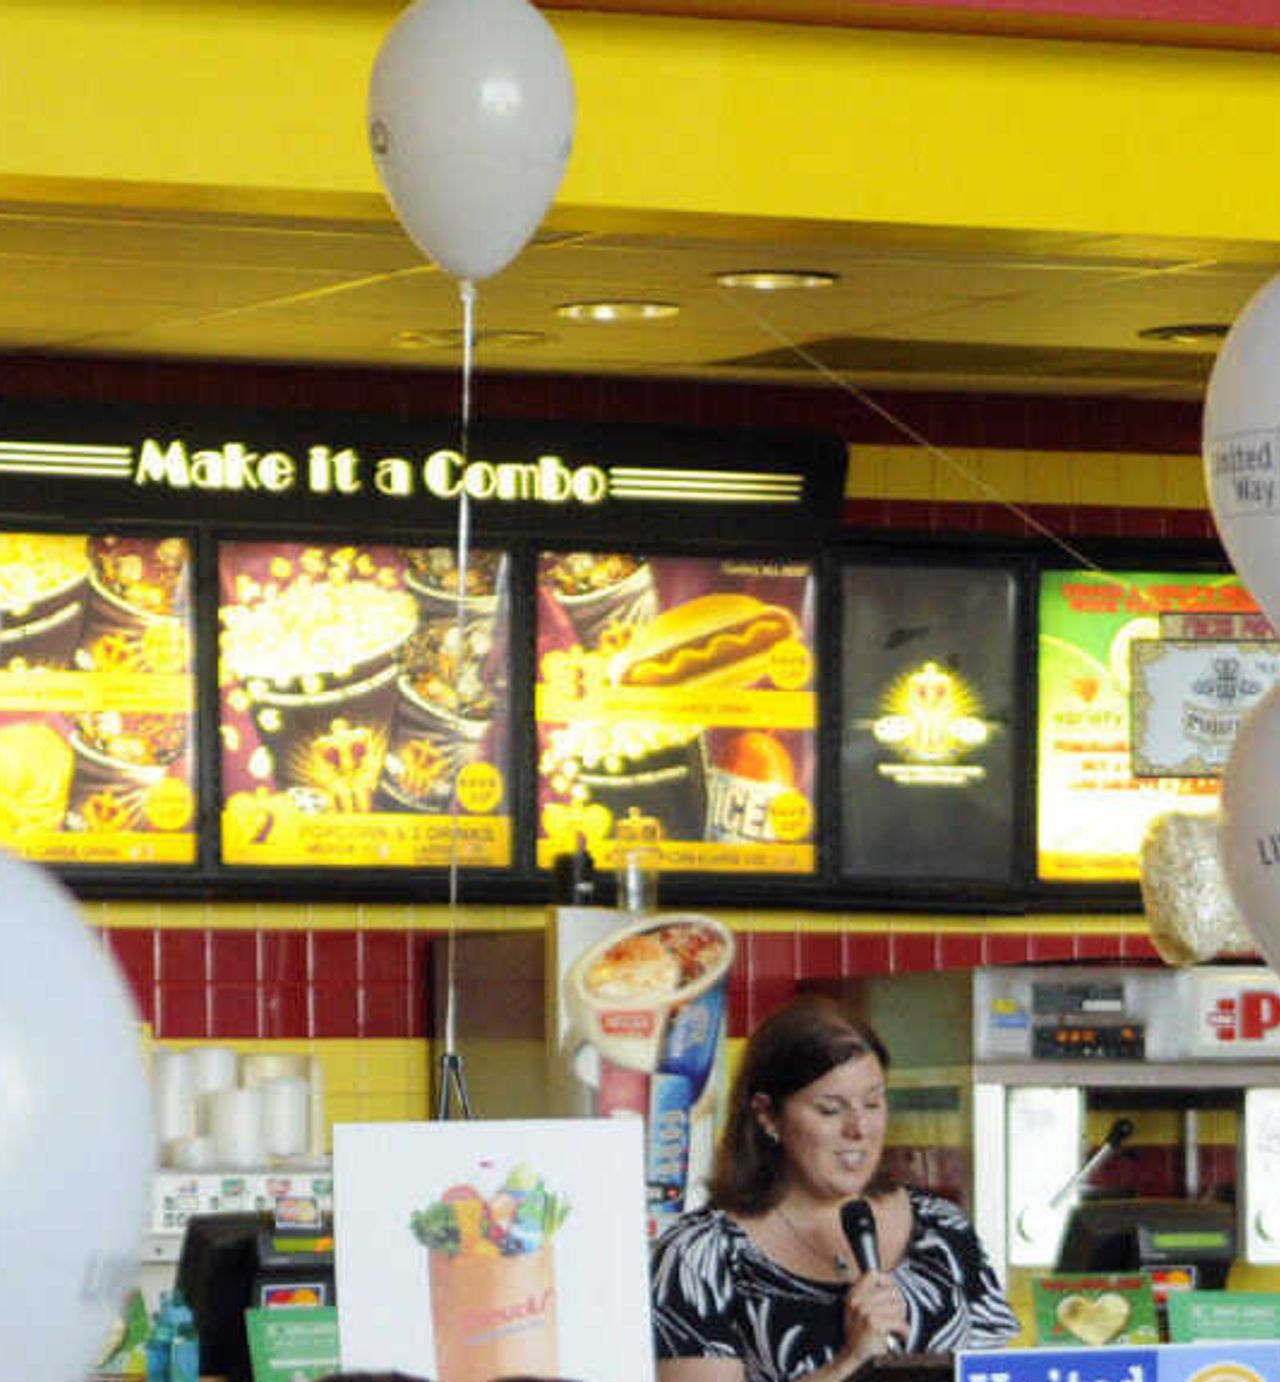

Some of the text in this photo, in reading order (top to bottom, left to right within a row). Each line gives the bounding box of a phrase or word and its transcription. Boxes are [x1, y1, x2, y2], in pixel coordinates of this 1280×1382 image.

[134, 438, 608, 503] Make it a Combo
